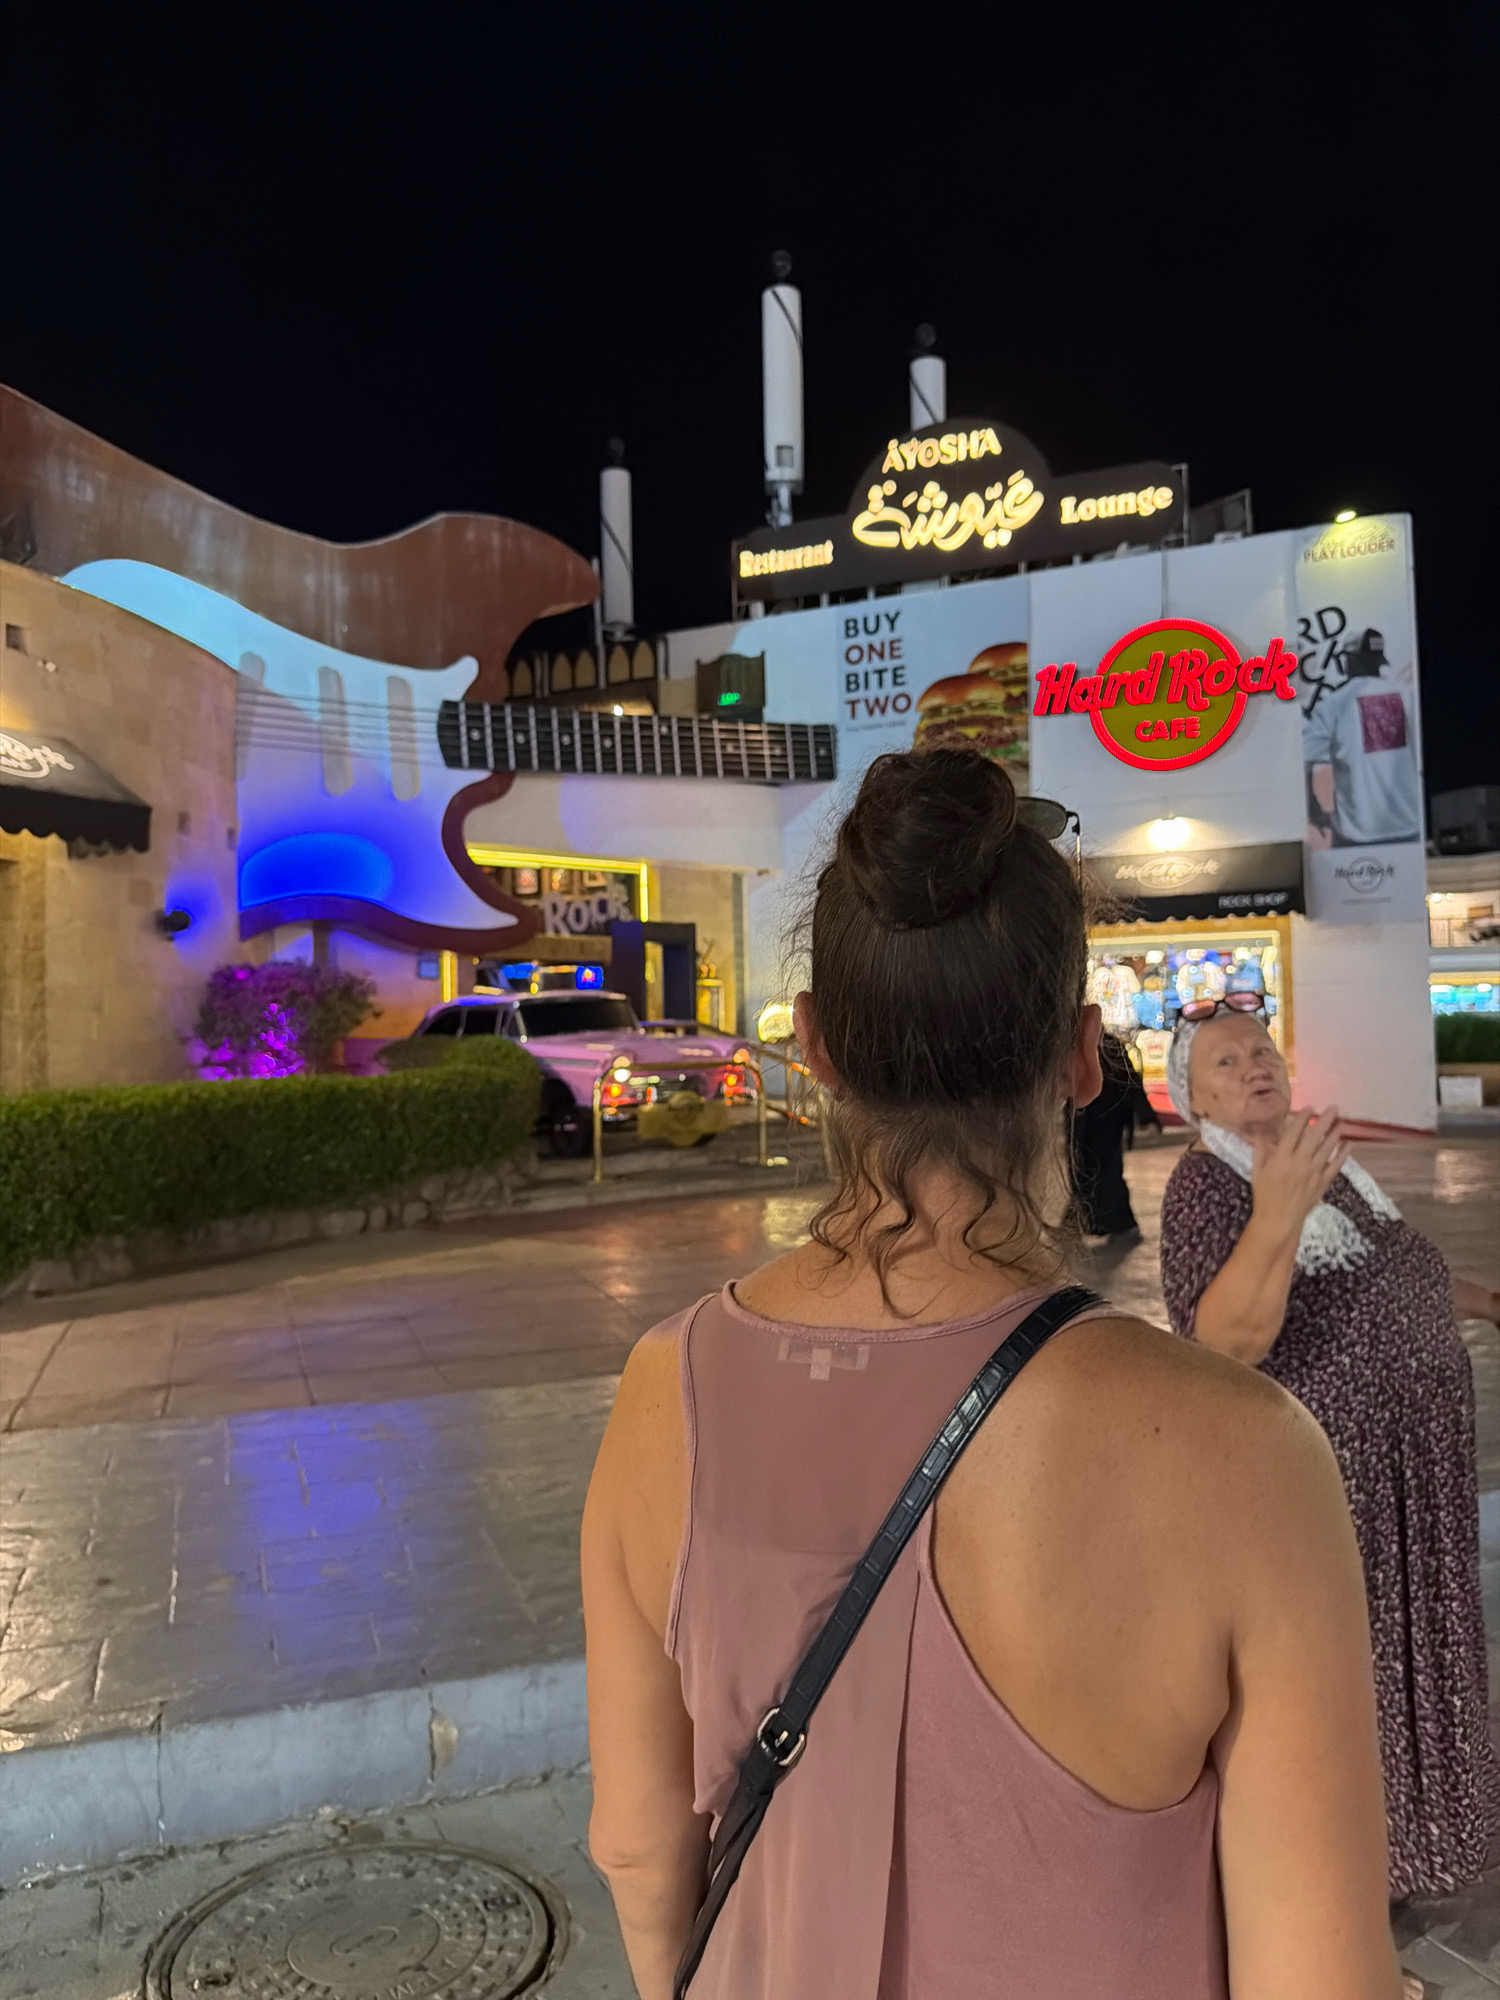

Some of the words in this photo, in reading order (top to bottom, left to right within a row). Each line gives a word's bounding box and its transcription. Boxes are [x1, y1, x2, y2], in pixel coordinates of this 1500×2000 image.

[1060, 486, 1174, 524] Lounge
[740, 540, 834, 577] Restaurant
[1303, 546, 1336, 562] PLAY
[1340, 537, 1395, 559] LOUDER
[844, 610, 901, 638] BUY
[844, 638, 903, 665] ONE
[845, 665, 906, 693] BITE
[1033, 651, 1165, 716] Hard
[1166, 637, 1299, 711] Rock
[844, 693, 912, 720] TWO
[1135, 717, 1201, 742] CAFE
